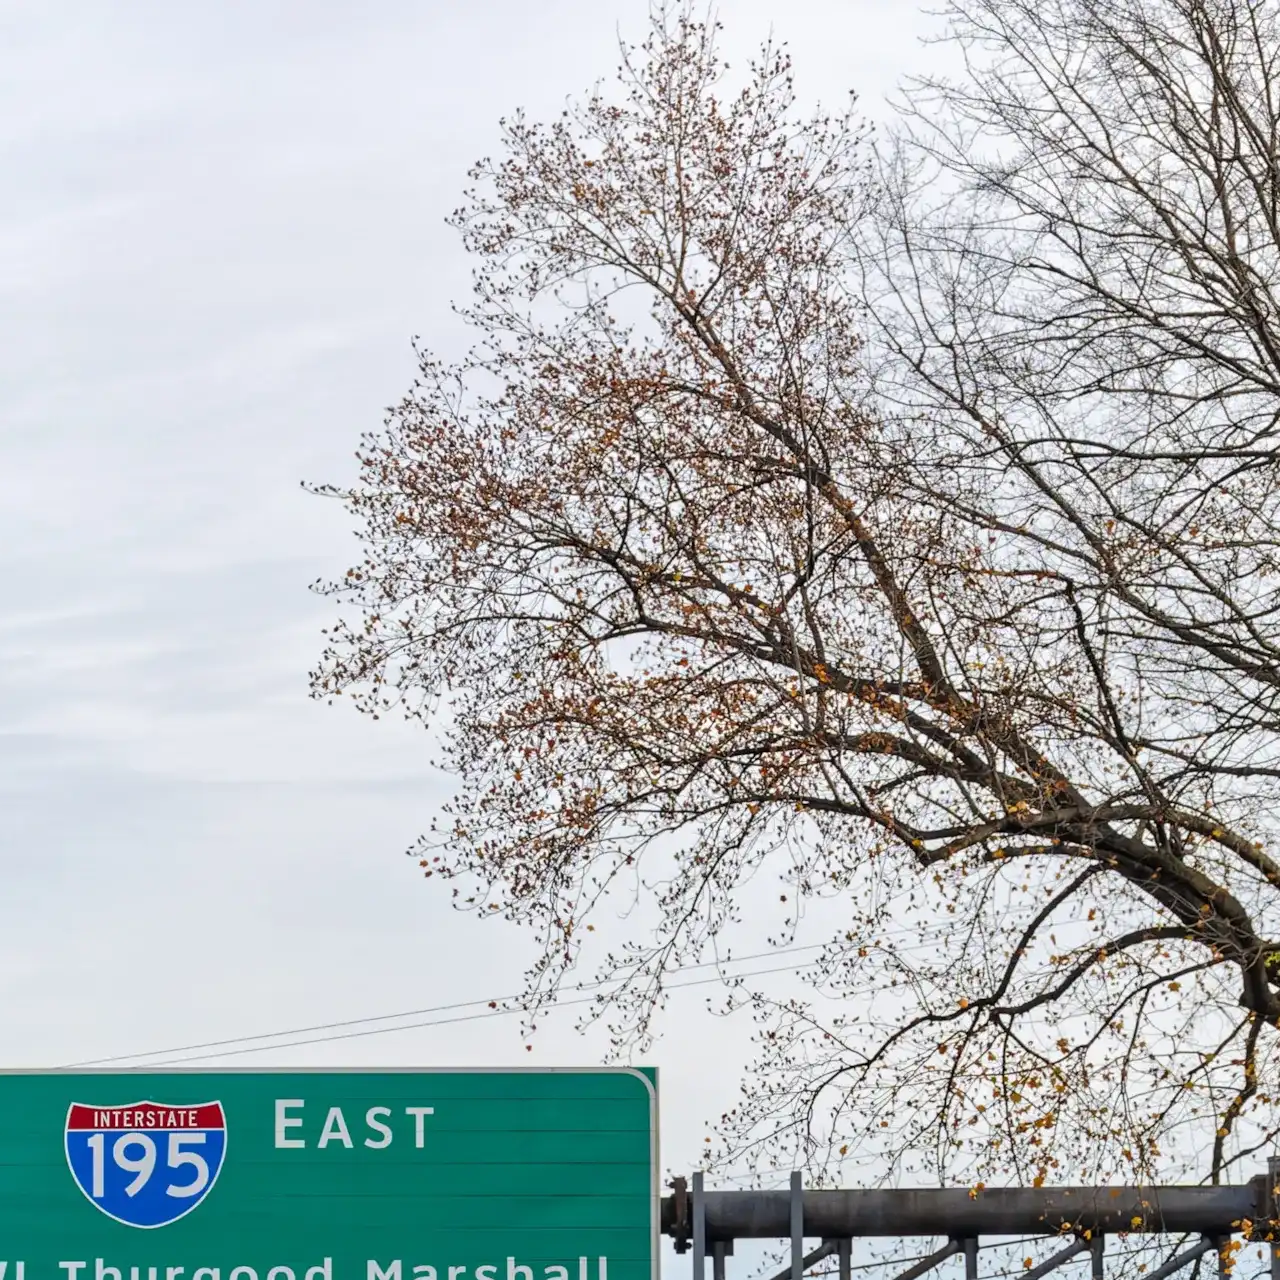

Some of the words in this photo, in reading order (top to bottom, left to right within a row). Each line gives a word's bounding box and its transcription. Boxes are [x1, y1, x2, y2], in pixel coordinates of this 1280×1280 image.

[92, 1109, 199, 1129] INTERSTATE
[274, 1098, 436, 1150] EAST
[86, 1132, 211, 1200] 195
